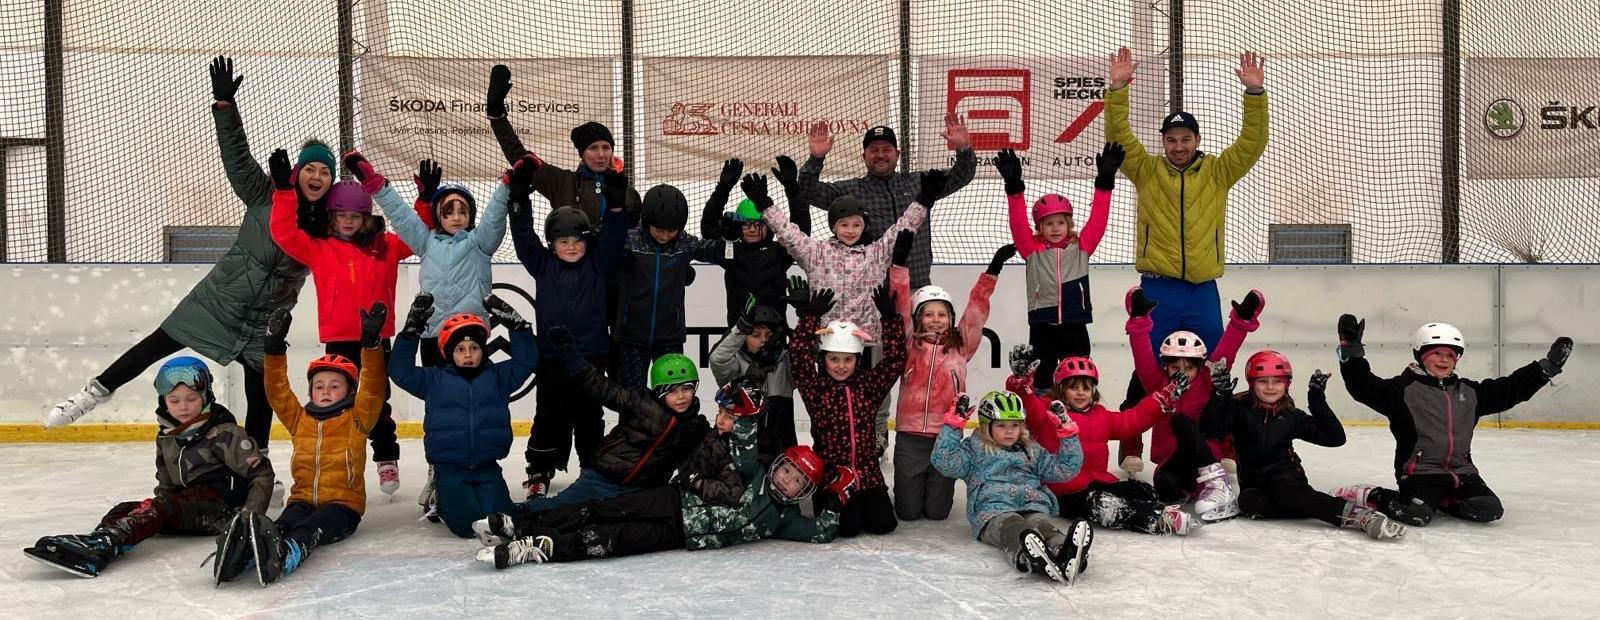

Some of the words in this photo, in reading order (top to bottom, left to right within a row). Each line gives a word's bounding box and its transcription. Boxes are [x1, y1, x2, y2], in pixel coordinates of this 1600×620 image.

[1053, 77, 1105, 88] SPIES
[1053, 89, 1106, 99] HECK
[389, 96, 446, 112] ŠKODA
[452, 99, 513, 113] Finanal
[518, 100, 580, 113] Services
[720, 102, 798, 117] GENERALI
[1540, 100, 1600, 129] ŠK
